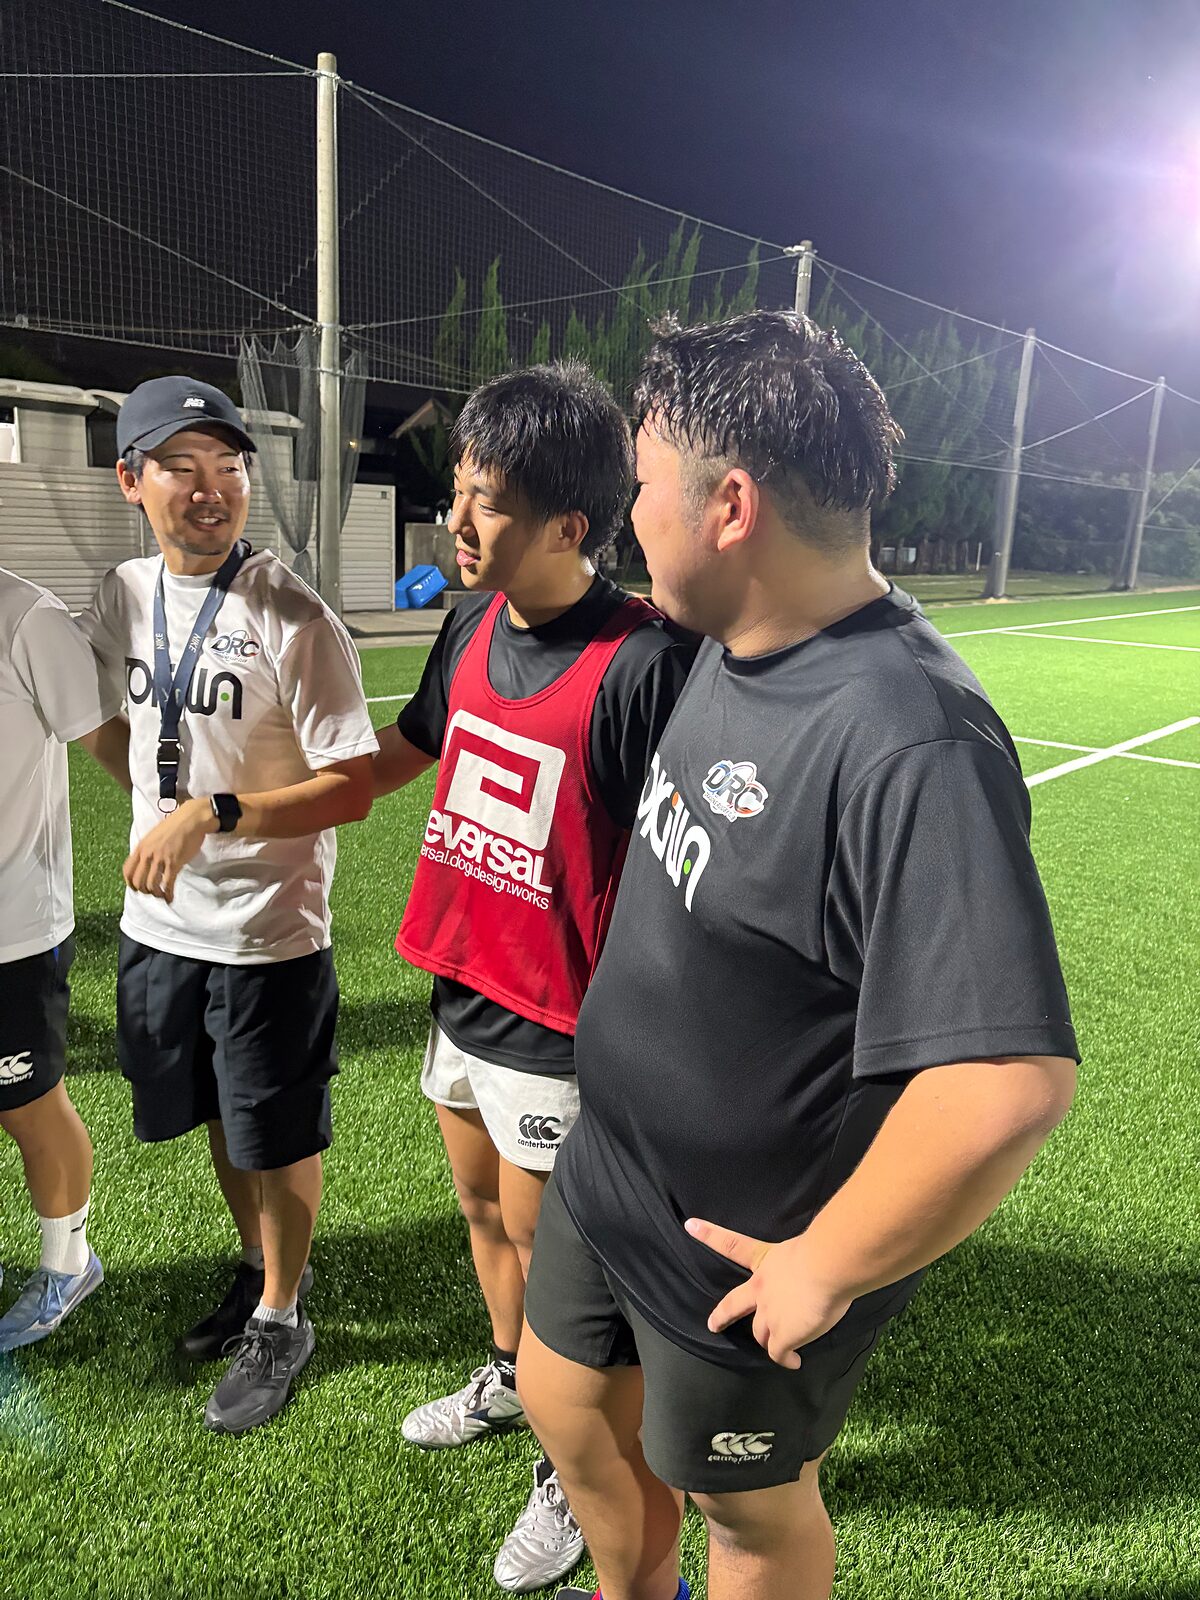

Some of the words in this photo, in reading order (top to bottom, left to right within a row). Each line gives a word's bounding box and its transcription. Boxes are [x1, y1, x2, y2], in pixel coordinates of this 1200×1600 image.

[155, 633, 165, 650] NIKE
[189, 632, 202, 653] NIKE
[211, 635, 260, 657] DRC
[705, 763, 763, 815] DRC
[517, 1139, 561, 1150] canterbury
